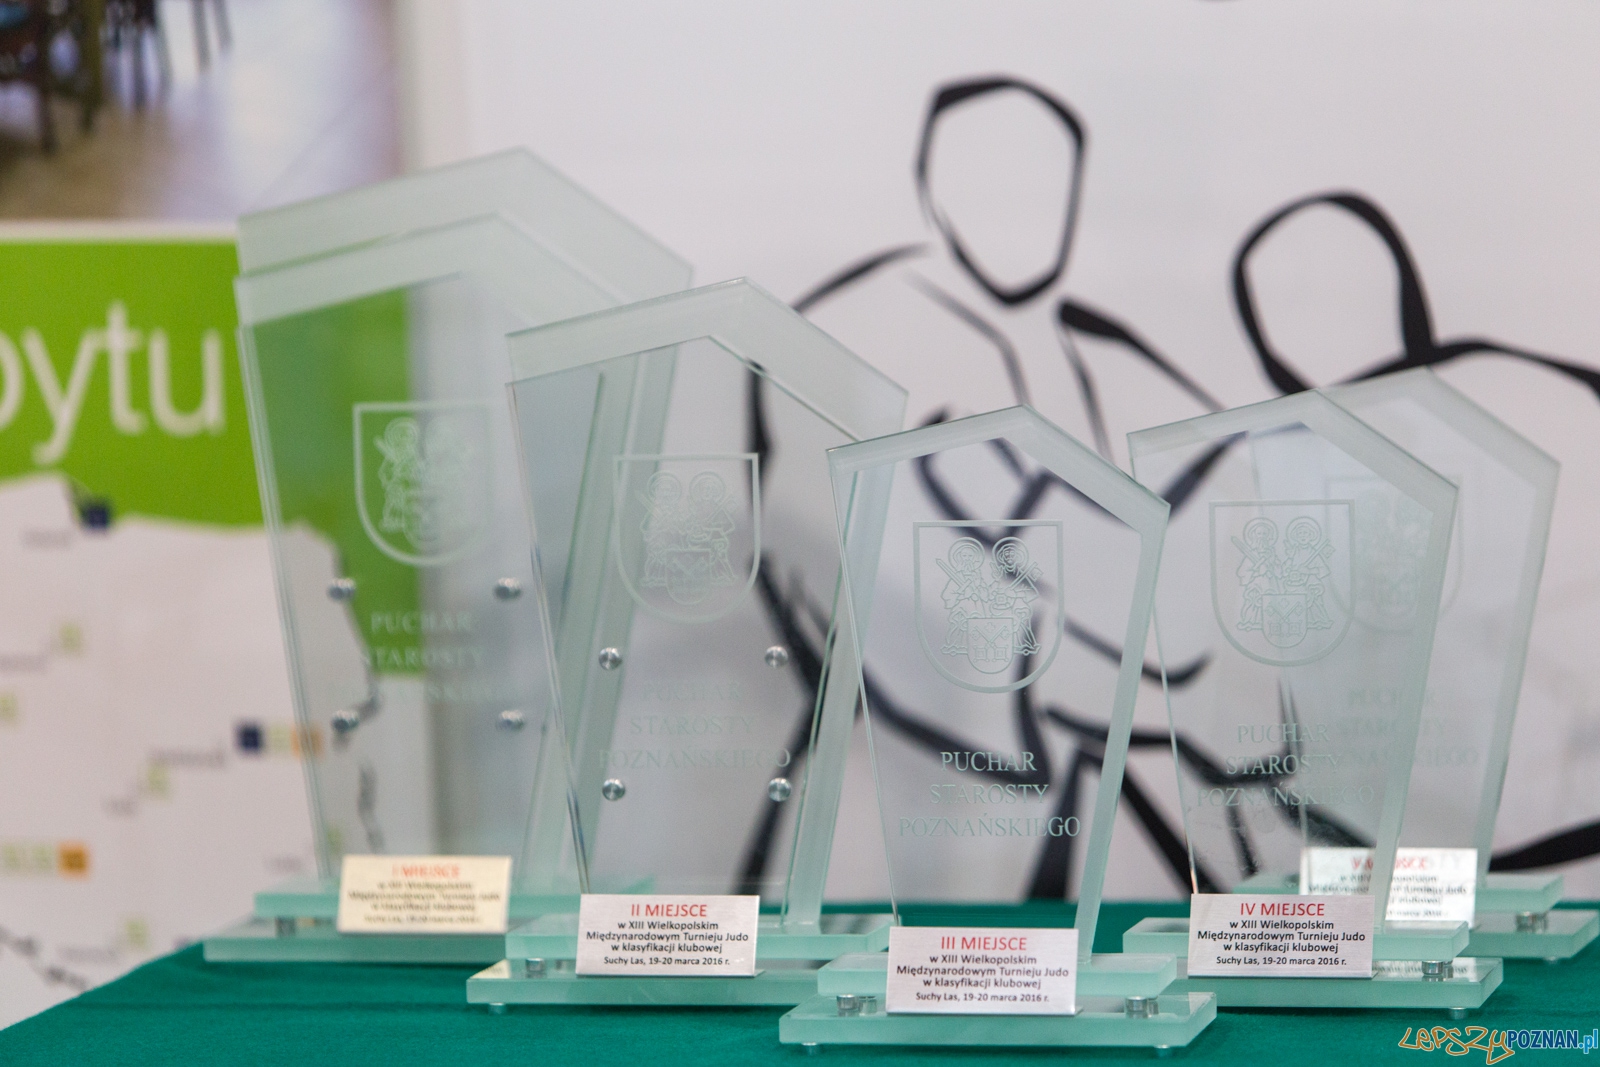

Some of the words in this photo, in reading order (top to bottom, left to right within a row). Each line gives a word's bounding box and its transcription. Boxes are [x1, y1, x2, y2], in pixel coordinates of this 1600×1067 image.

[1237, 722, 1330, 744] PUCHAR
[939, 751, 1037, 772] PUCHAR
[1225, 754, 1340, 775] STAROSTY
[930, 783, 1049, 804] STAROSTY
[899, 812, 1081, 837] POZNAŃSKIEGO
[631, 903, 640, 917] II
[645, 904, 708, 917] MIEJSCE
[1240, 903, 1256, 916] IV
[1261, 903, 1325, 916] MIEJSCE
[628, 921, 644, 929] XIII
[647, 921, 718, 931] Wielkopolskim
[1241, 920, 1257, 929] XIII
[1260, 920, 1334, 930] Wielkopolskim
[586, 931, 680, 941] Międzynarodowym
[683, 932, 723, 942] Turnieju
[725, 932, 749, 941] Judo
[1197, 930, 1294, 941] Międzynarodowym
[1298, 931, 1339, 942] Turnieju
[1341, 931, 1366, 941] Judo
[622, 943, 675, 953] klasyfikacji
[678, 943, 722, 954] klubowej
[941, 936, 955, 950] III
[961, 936, 1027, 951] MIEJSCE
[1234, 942, 1289, 953] klasyfikacji
[1292, 942, 1339, 953] klubowej
[604, 956, 628, 965] Suchy
[630, 957, 646, 965] Las,
[649, 957, 673, 965] 19-20
[702, 957, 723, 965] 2016
[941, 954, 957, 963] XIII
[961, 954, 1037, 965] Wielkopolskim
[1216, 956, 1241, 966] Suchy
[1243, 957, 1260, 966] Las,
[1262, 957, 1287, 965] 19-20
[896, 965, 996, 976] Międzynarodowym
[999, 966, 1042, 977] Turnieju
[1044, 966, 1069, 977] Judo
[934, 977, 991, 989] klasyfikacji
[994, 978, 1041, 989] klubowej
[916, 992, 941, 1002] Suchy
[943, 993, 960, 1002] Las,
[963, 993, 988, 1001] 19-20
[1020, 994, 1042, 1002] 2016
